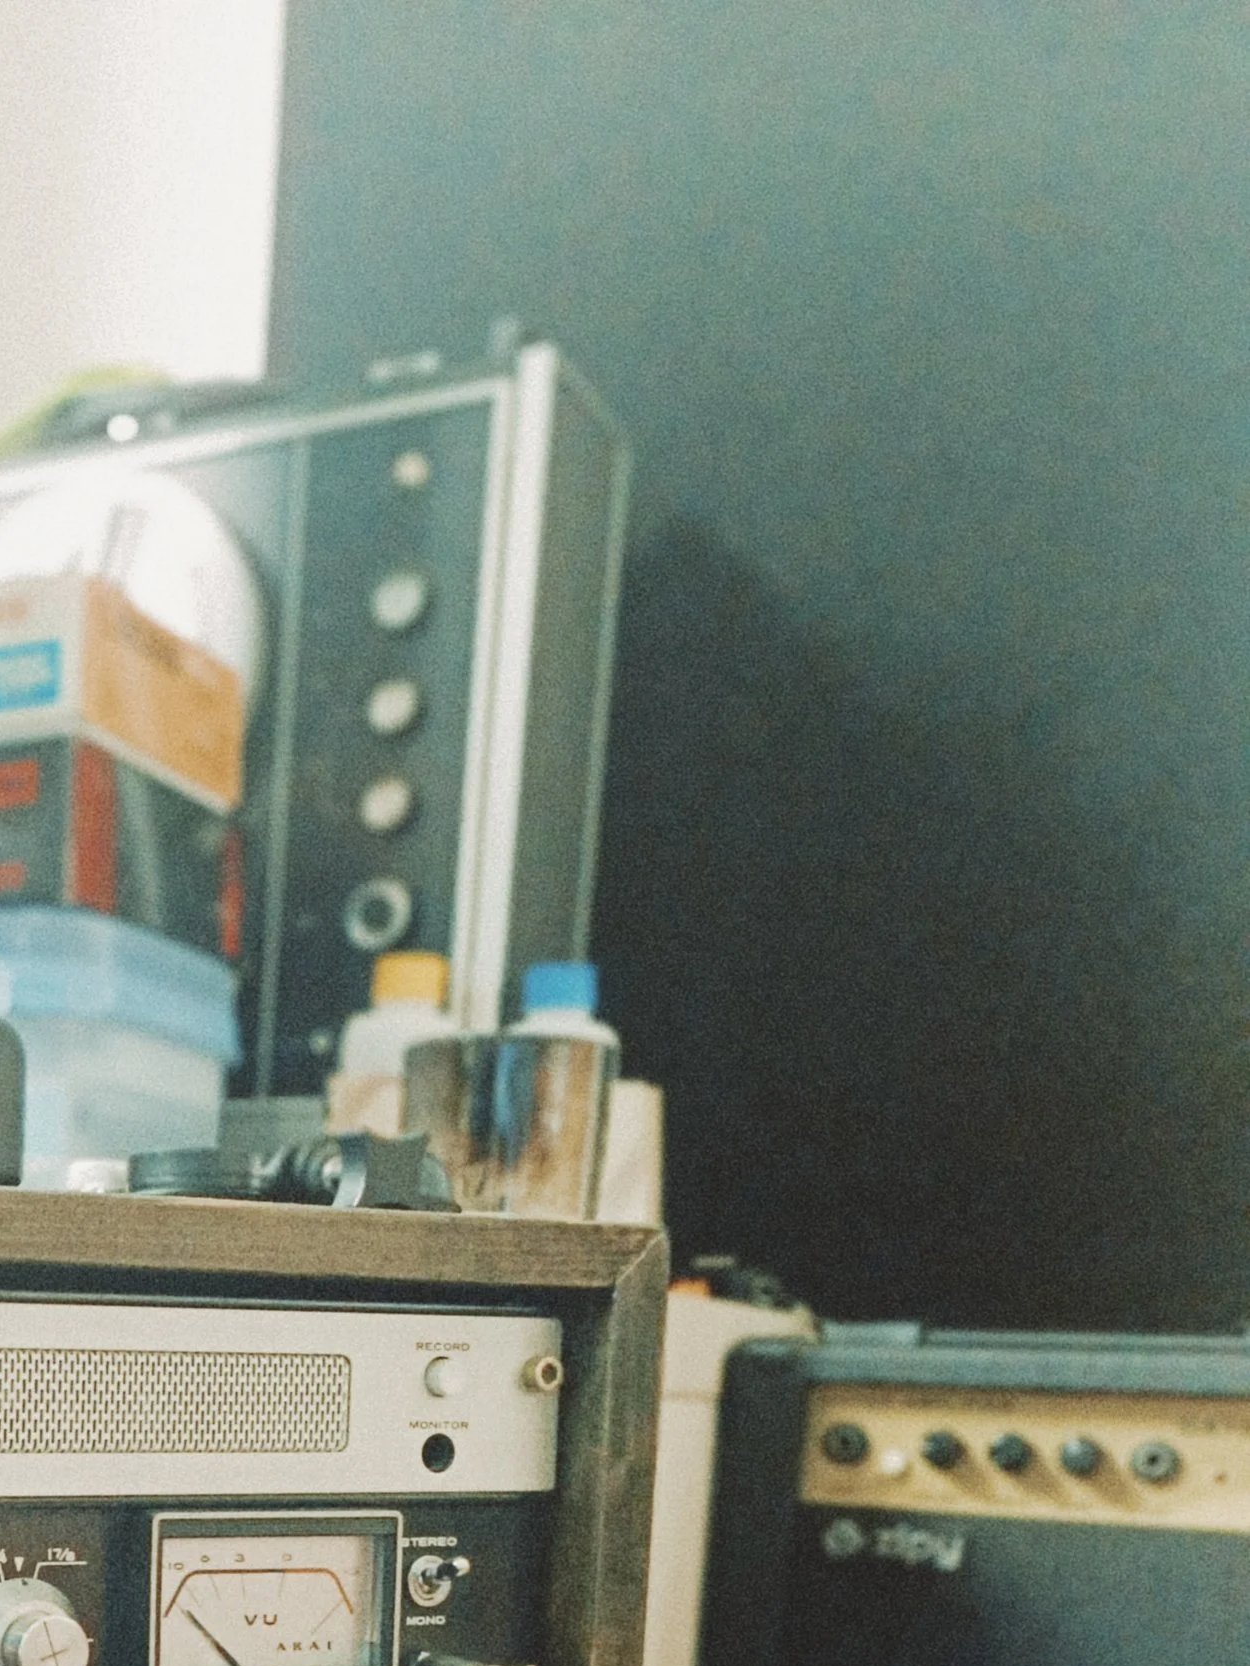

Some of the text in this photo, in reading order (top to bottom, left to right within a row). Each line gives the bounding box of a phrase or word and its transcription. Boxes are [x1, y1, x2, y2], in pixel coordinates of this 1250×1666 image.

[415, 1341, 471, 1352] RECORD
[408, 1420, 469, 1430] MONITOR
[401, 1536, 458, 1548] STEREO
[243, 1613, 279, 1626] VU
[405, 1615, 447, 1626] MONO
[275, 1640, 334, 1652] AKAI
